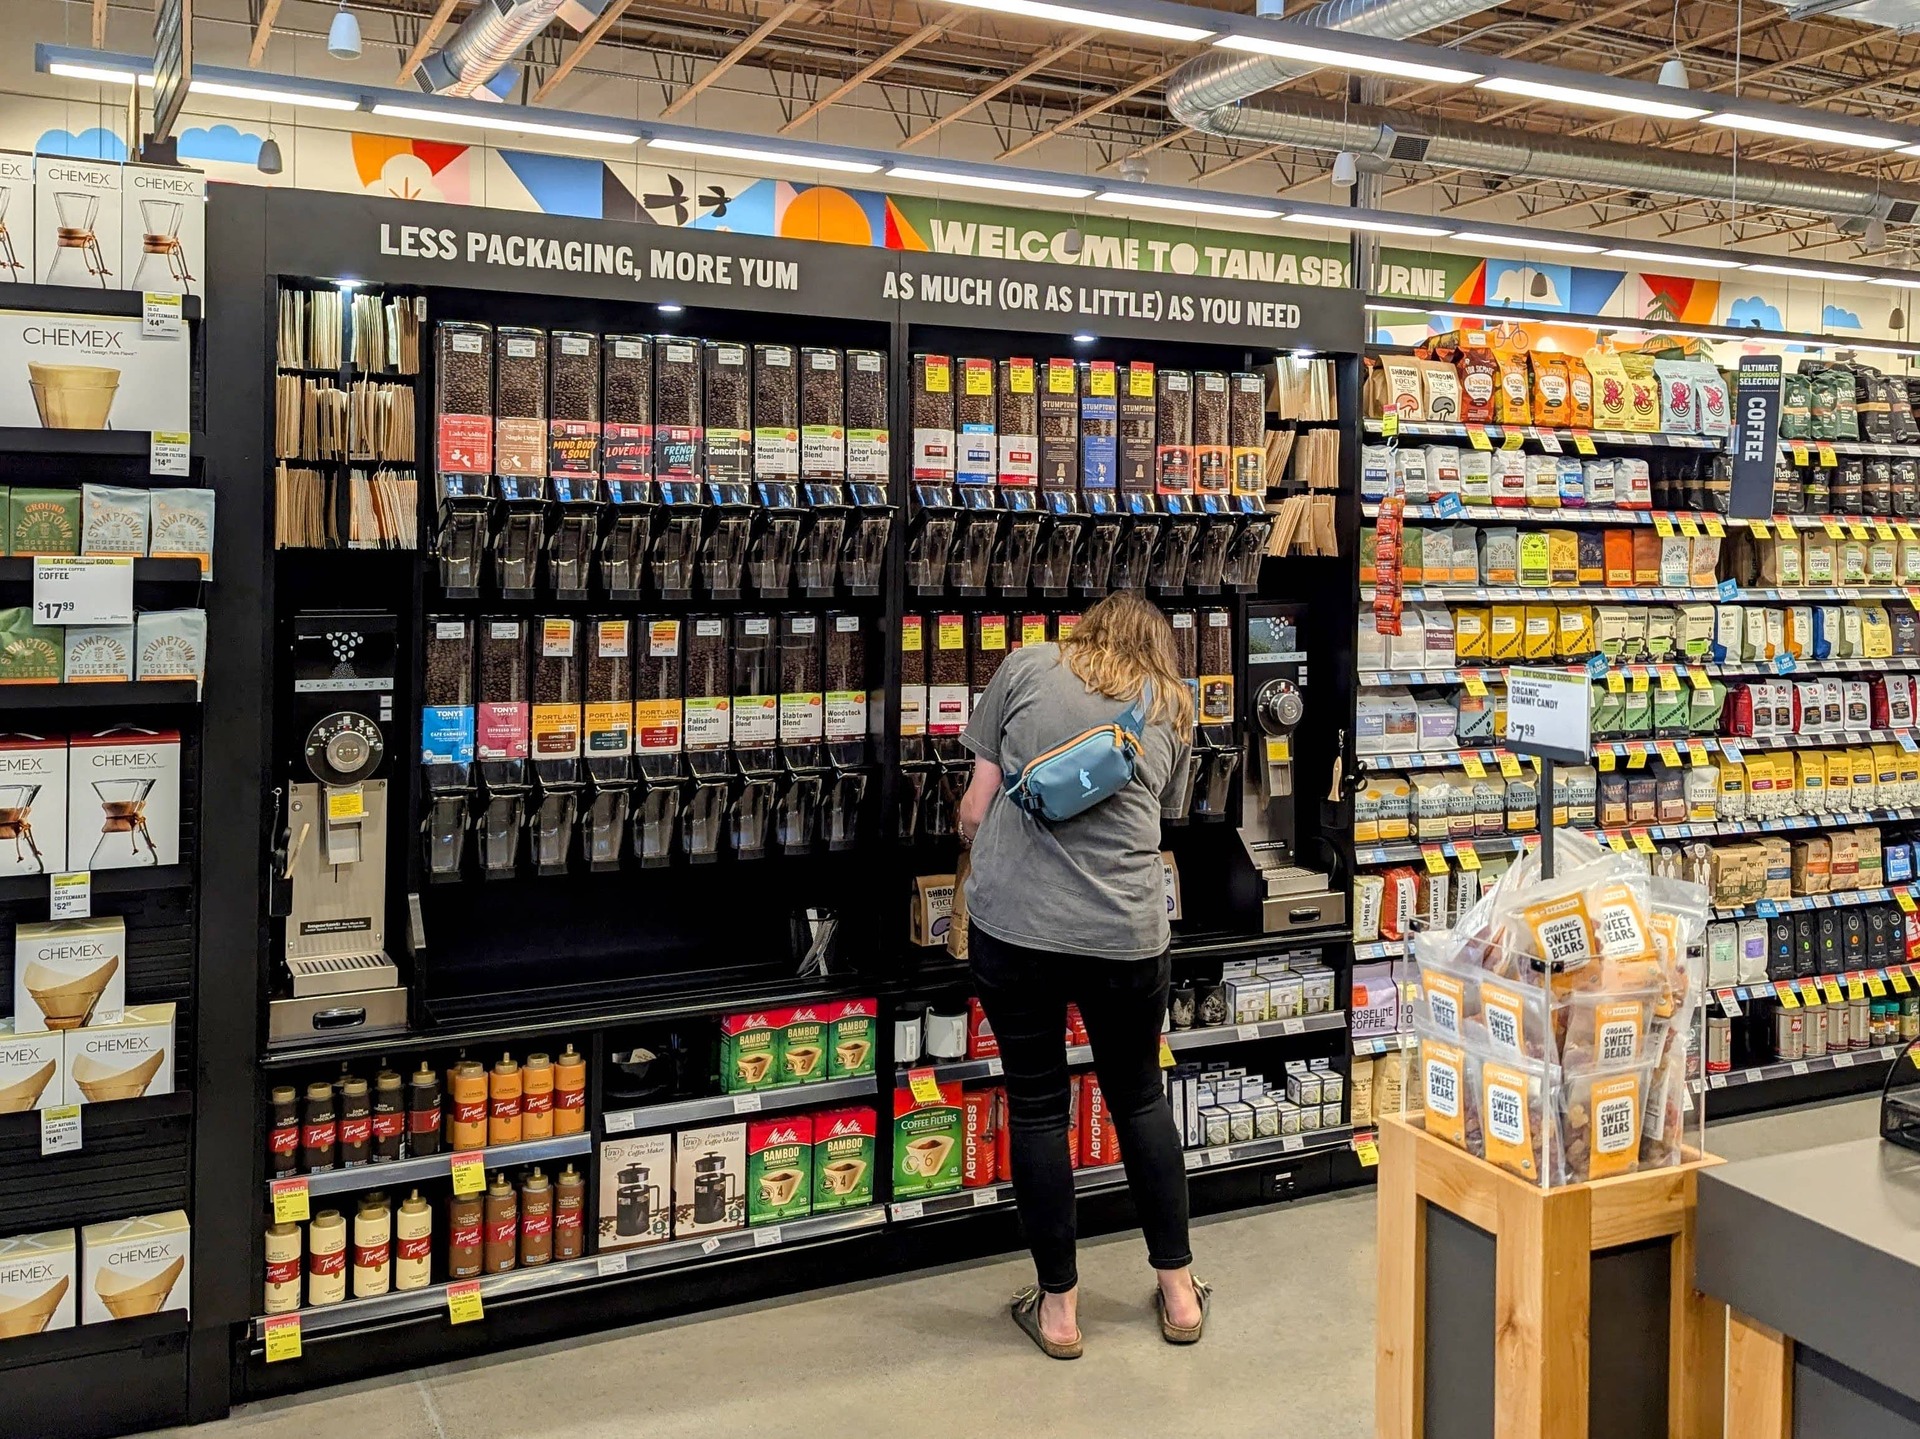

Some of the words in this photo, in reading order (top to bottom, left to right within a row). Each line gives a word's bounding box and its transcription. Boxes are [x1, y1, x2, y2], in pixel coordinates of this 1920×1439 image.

[48, 168, 110, 185] CHEMEX
[134, 176, 194, 193] CHEMEX
[380, 224, 457, 260] LESS
[467, 231, 642, 282] PACKAGING,
[650, 249, 732, 285] MORE
[738, 257, 798, 291] YUM
[931, 218, 1138, 271] WELCOME
[1148, 240, 1199, 275] TO
[1205, 247, 1445, 298] TANASBURNE
[883, 271, 914, 300] AS
[920, 274, 992, 306] MUCH
[998, 276, 1039, 312] (OR
[1044, 284, 1074, 313] AS
[1079, 287, 1163, 322] LITTLE)
[1167, 294, 1196, 322] AS
[1199, 296, 1242, 325] YOU
[1246, 301, 1300, 330] NEED
[23, 327, 121, 349] CHEMEX
[1742, 364, 1778, 372] ULTIMATE
[1739, 377, 1779, 386] SELECTION
[1744, 396, 1767, 462] COFFEE
[664, 446, 697, 456] FRENCH
[709, 446, 748, 456] Concordia
[757, 446, 785, 454] Mountain
[804, 444, 840, 452] Hawthorne
[804, 451, 823, 459] Blend
[870, 449, 887, 457] Lodge
[669, 454, 693, 464] ROAST
[25, 502, 65, 514] GROUND
[16, 511, 73, 539] STUMPTOWN
[88, 512, 142, 539] STUMPTOWN
[155, 513, 208, 540] STUMPTOWN
[38, 572, 70, 580] COFFEE
[1, 637, 57, 664] STUMPTOWN
[70, 635, 126, 662] STUMPTOWN
[143, 635, 196, 662] STUMPTOWN
[1511, 686, 1539, 697] ORGANIC
[1511, 695, 1535, 707] GUMMY
[1537, 699, 1558, 710] CANDY
[782, 712, 812, 720] Slabtown
[827, 709, 861, 717] Woodstock
[687, 717, 719, 725] Palisades
[687, 724, 707, 732] Blend
[0, 758, 43, 772] EMEX
[92, 752, 158, 767] CHEMEX
[1547, 900, 1578, 914] SEASONS
[1604, 909, 1627, 919] ANIC
[1544, 919, 1578, 935] ORGANIC
[1604, 916, 1631, 931] WEET
[1546, 927, 1581, 947] SWEET
[38, 944, 104, 961] CHEMEX
[1552, 940, 1584, 959] BEARS
[790, 1009, 816, 1022] Melitta
[1351, 1007, 1393, 1020] ROSELINE
[1432, 1002, 1455, 1019] SWEET
[742, 1014, 768, 1029] Melitta
[838, 1020, 868, 1032] BAMBOO
[1351, 1018, 1386, 1030] COFFEE
[1489, 1016, 1514, 1034] SWEET
[740, 1032, 770, 1045] BAMBOO
[788, 1026, 819, 1038] BAMBOO
[1606, 1026, 1632, 1036] ORGANIC
[86, 1036, 150, 1053] CHEMEX
[1604, 1034, 1634, 1047] SWEET
[1604, 1046, 1632, 1059] BEARS
[1431, 1064, 1454, 1078] ORGANIC
[1430, 1074, 1454, 1090] SWEET
[1431, 1084, 1454, 1101] BEARS
[1492, 1090, 1517, 1104] ORGANIC
[495, 1101, 516, 1115] Torani
[527, 1096, 549, 1110] Torani
[1491, 1099, 1519, 1116] SWEET
[1602, 1101, 1628, 1113] ORGANIC
[461, 1106, 485, 1120] Torani
[1493, 1112, 1519, 1128] BEARS
[1601, 1110, 1630, 1126] SWEET
[829, 1119, 862, 1136] Melitta
[901, 1118, 929, 1130] COFFEE
[930, 1114, 957, 1126] FILTERS
[1090, 1087, 1102, 1159] AeroPress
[1602, 1121, 1630, 1138] BEARS
[309, 1125, 333, 1143] Torani
[343, 1122, 367, 1139] Torani
[765, 1128, 798, 1145] Melitta
[828, 1138, 863, 1151] BAMBOO
[965, 1104, 977, 1179] AeroPress
[763, 1147, 800, 1161] BAMBOO
[525, 1217, 547, 1233] Torani
[108, 1244, 170, 1265] CHEMEX
[363, 1247, 386, 1264] Torani
[1, 1264, 54, 1284] HEMEX
